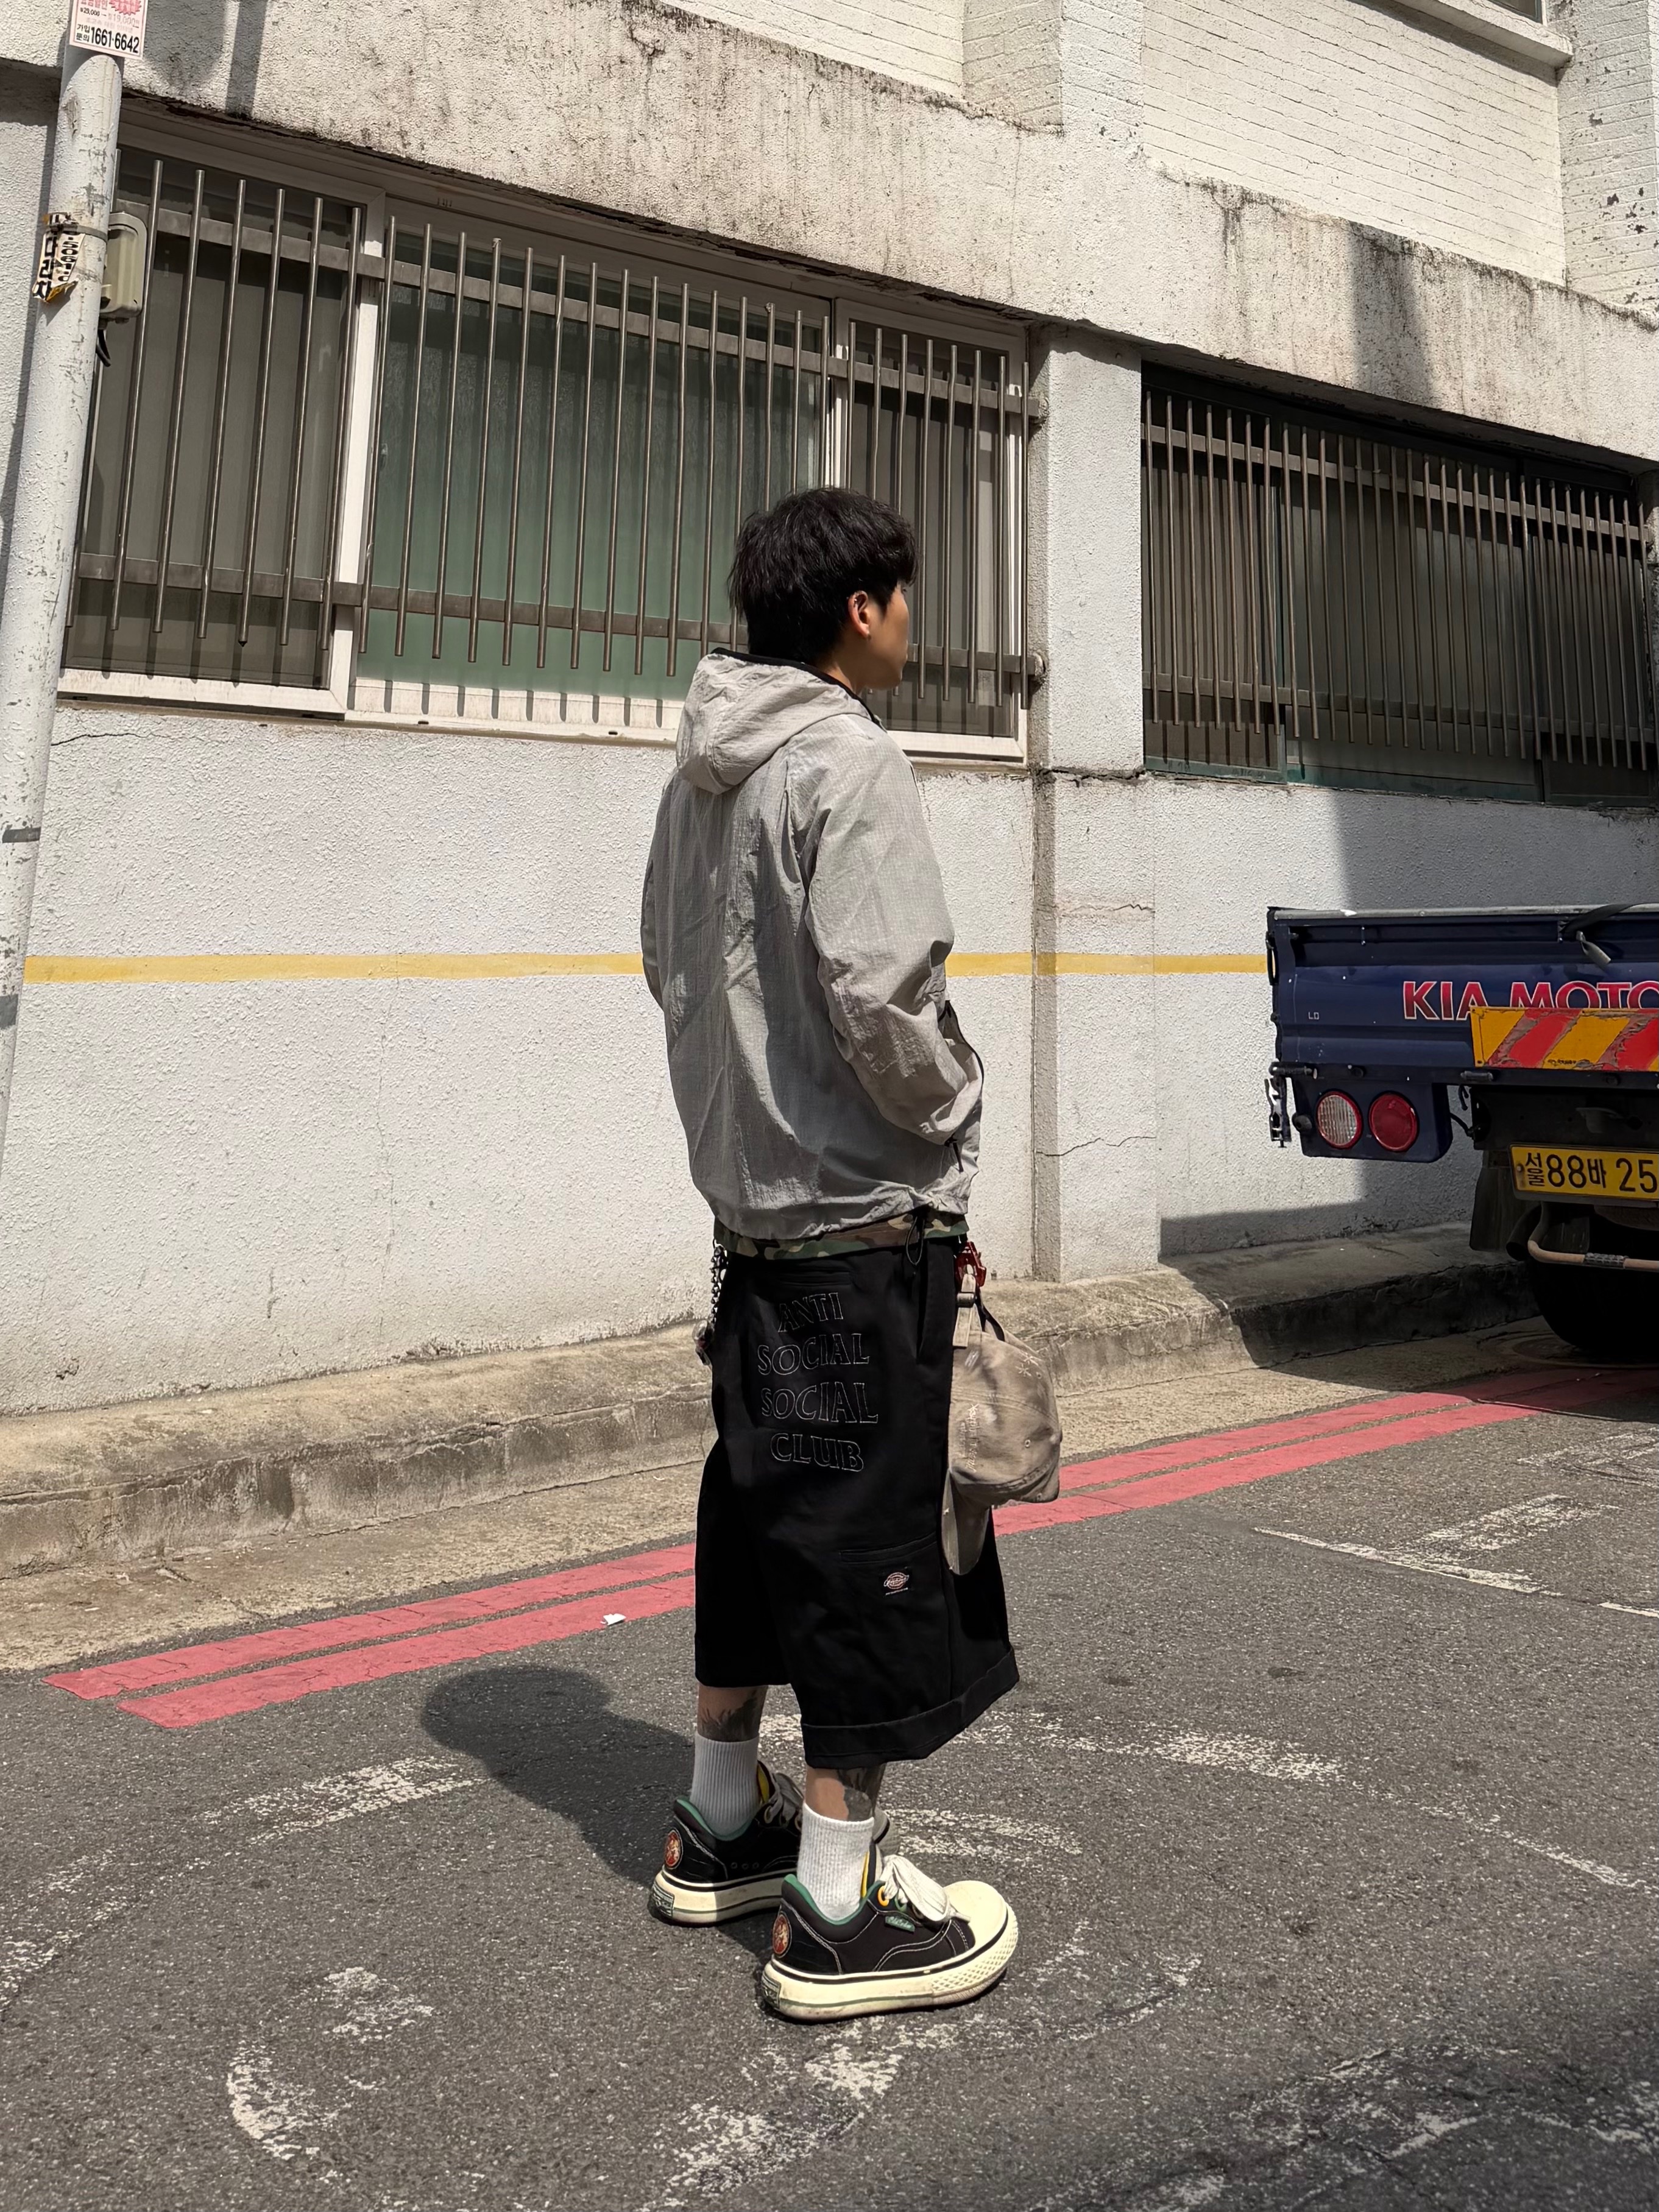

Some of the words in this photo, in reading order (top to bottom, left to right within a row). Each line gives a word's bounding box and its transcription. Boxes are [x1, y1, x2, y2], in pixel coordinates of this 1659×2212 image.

[1403, 981, 1488, 1021] KIA
[1615, 1157, 1658, 1193] 25
[777, 1292, 844, 1333] ANTI
[757, 1333, 871, 1376] SOCIAL
[761, 1381, 879, 1424] SOCIAL
[770, 1432, 865, 1472] CLUB
